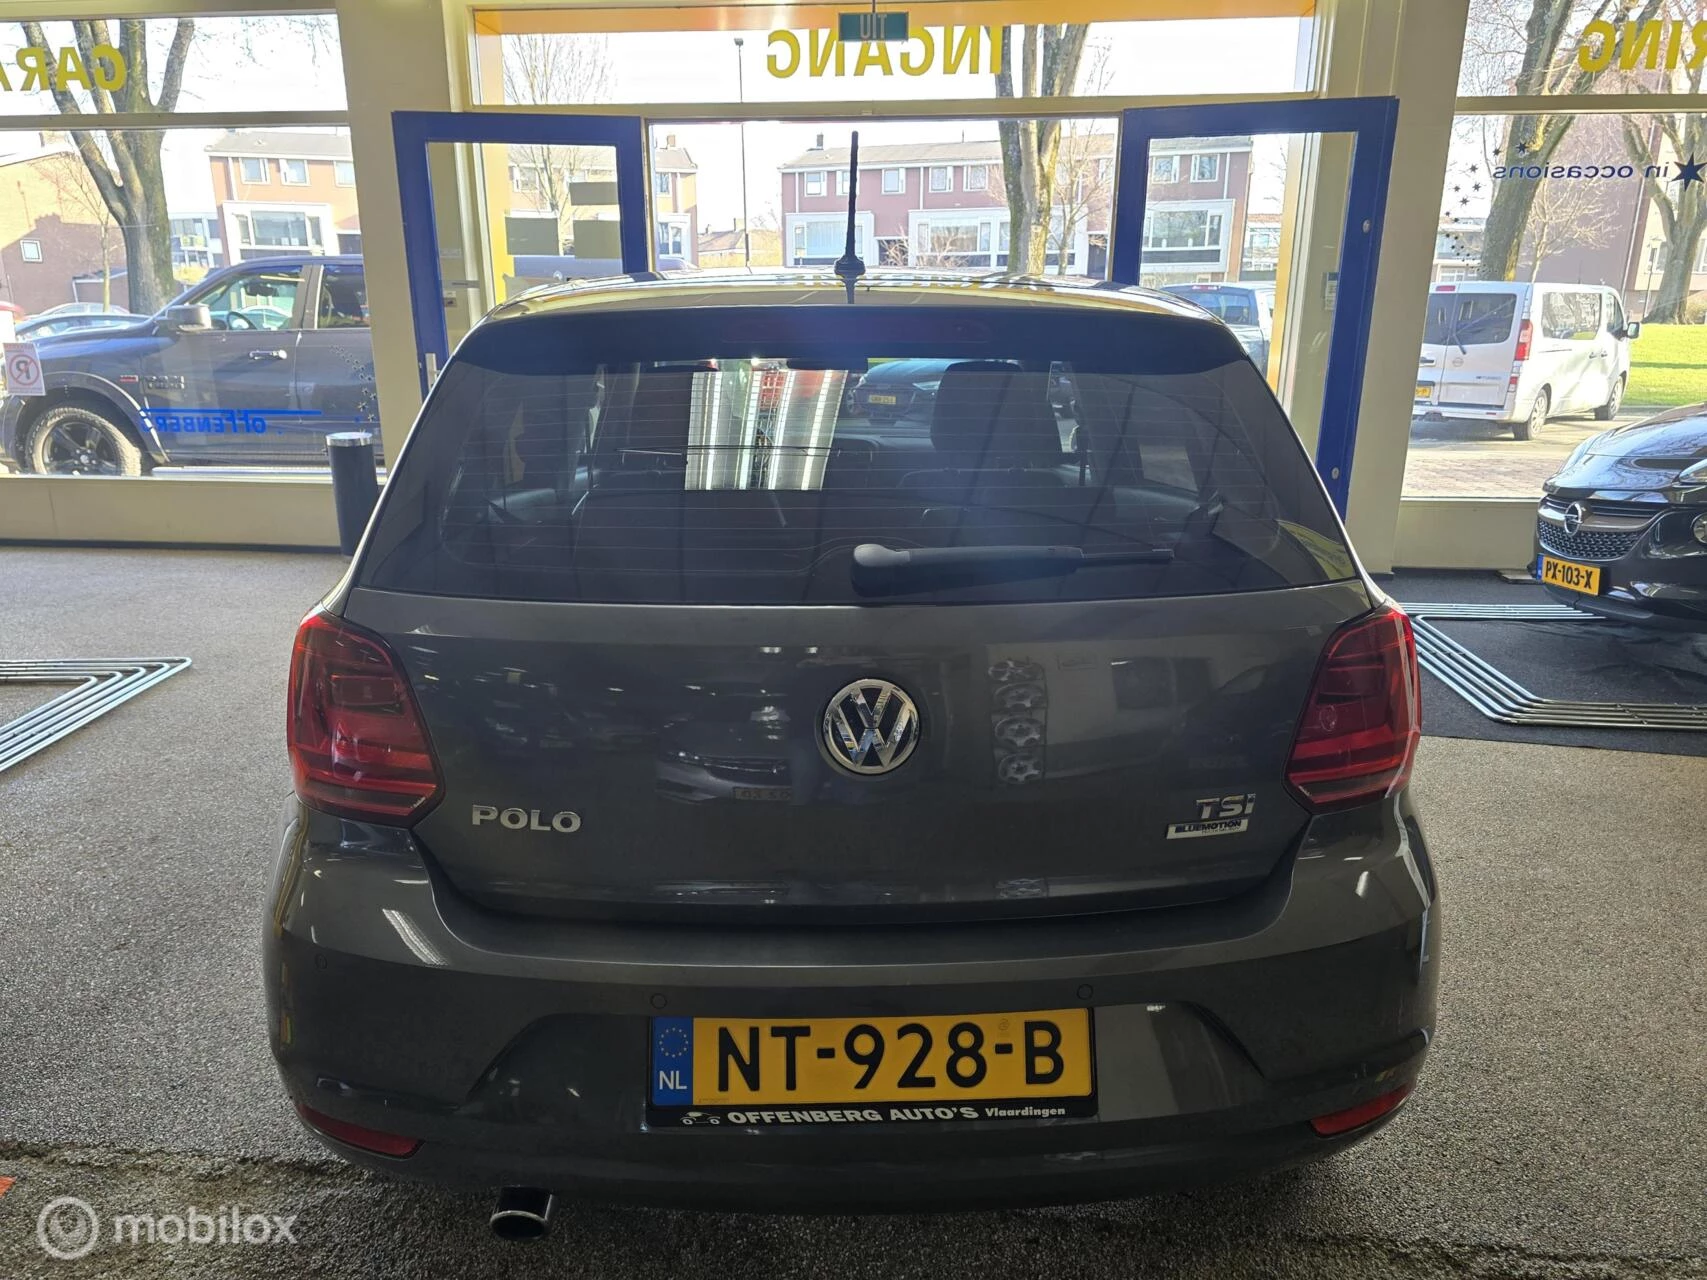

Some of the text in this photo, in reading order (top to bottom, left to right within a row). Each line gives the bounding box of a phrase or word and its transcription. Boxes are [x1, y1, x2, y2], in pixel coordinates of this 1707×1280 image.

[860, 13, 887, 39] UIT
[1545, 560, 1593, 589] PX-103-X
[472, 804, 582, 833] POLO
[718, 1020, 1065, 1092] NT-928-B
[658, 1070, 688, 1091] NL
[727, 1106, 1066, 1125] OFFENBERG AUTO'S Vlaardingen
